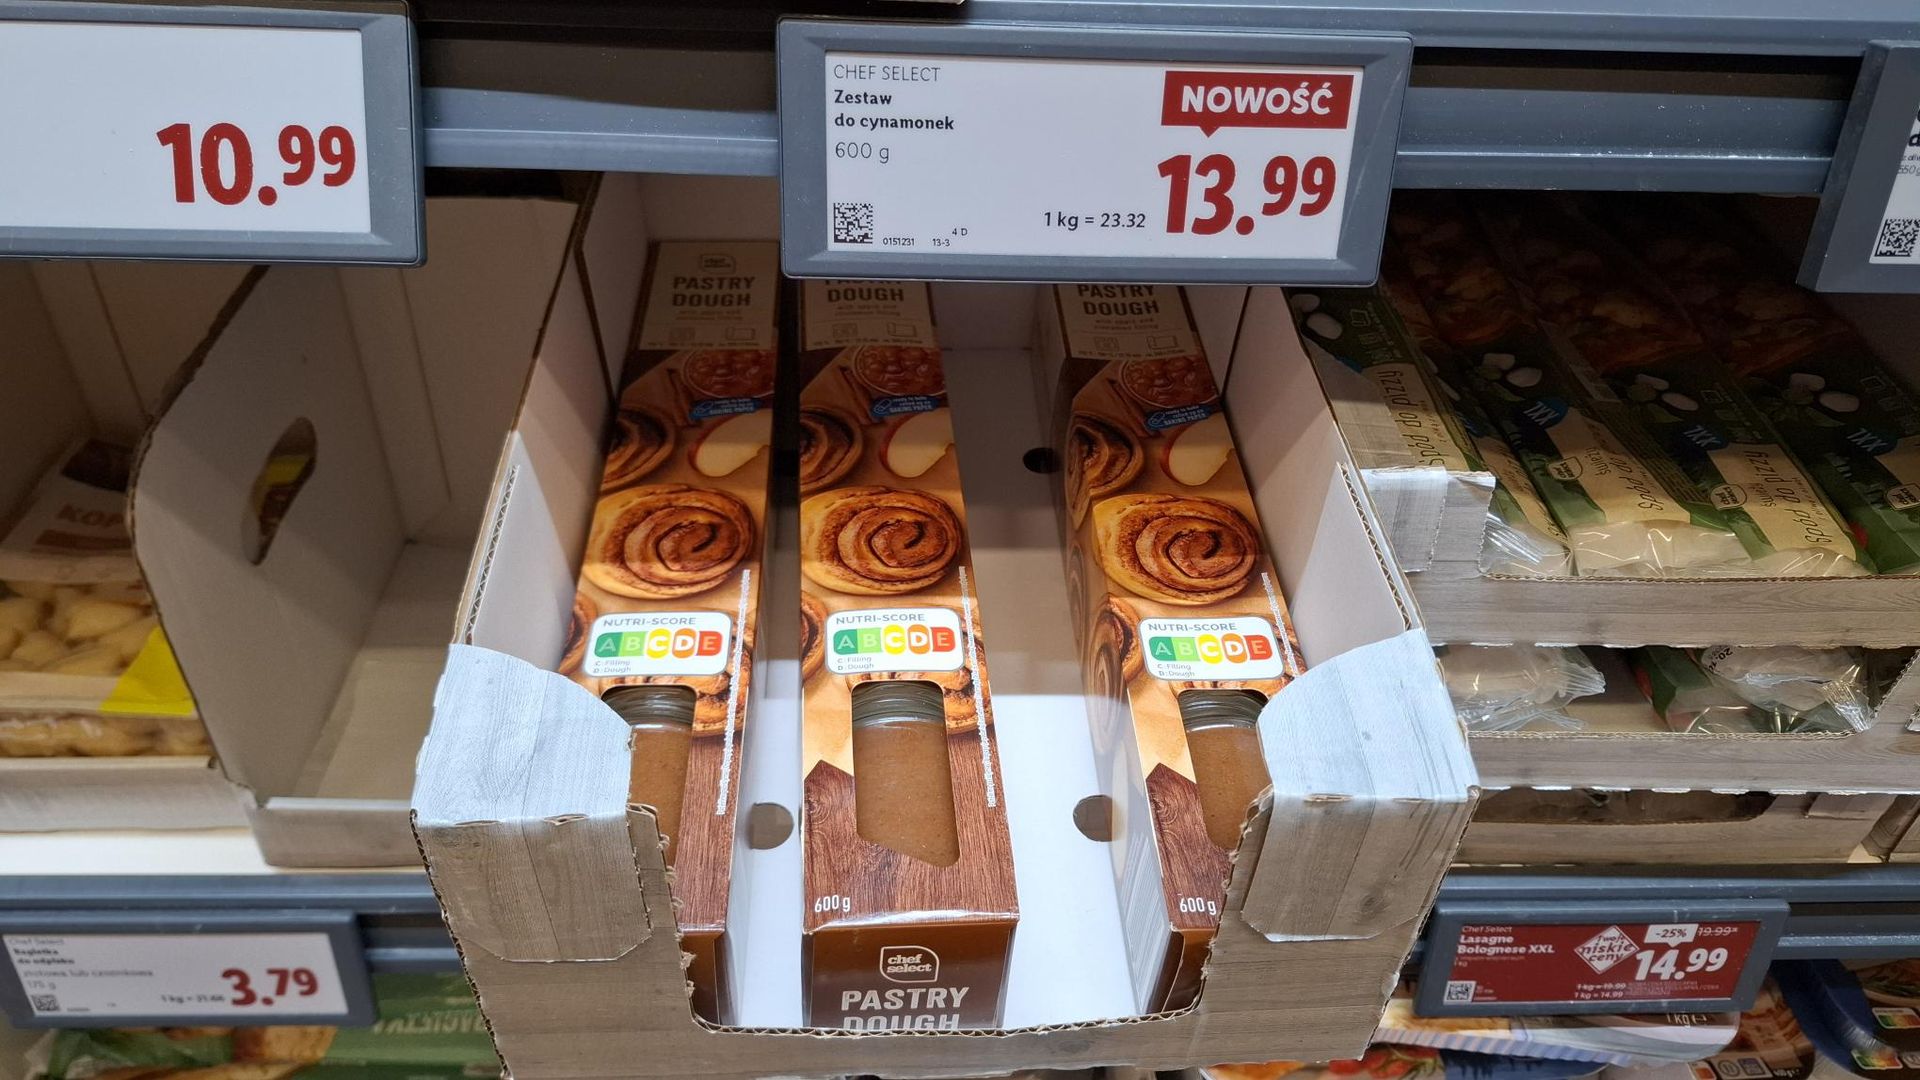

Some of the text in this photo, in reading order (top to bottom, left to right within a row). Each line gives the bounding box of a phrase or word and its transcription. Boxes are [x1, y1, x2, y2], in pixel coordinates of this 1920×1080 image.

[834, 64, 941, 82] CHEF SELECT
[834, 89, 893, 105] Zestaw
[1181, 81, 1334, 115] NOWOŚĆ
[834, 113, 955, 131] do cynamonek
[835, 142, 890, 164] 600 g
[155, 122, 356, 206] 10.99
[1157, 153, 1337, 236] 13.99
[1044, 211, 1147, 231] 1 kg = 23.32
[883, 238, 915, 247] 0151231
[932, 238, 950, 247] 13-3
[673, 276, 755, 290] PASTRY
[1077, 284, 1154, 298] PASTRY
[672, 293, 752, 307] DOUGH
[828, 287, 904, 303] DOUGH
[1083, 300, 1160, 316] DOUGH
[1378, 369, 1419, 407] pizzy
[1395, 411, 1421, 428] do
[1523, 400, 1560, 426] XXL
[1743, 450, 1794, 483] pizzy
[1617, 476, 1665, 512] Spód
[1775, 487, 1801, 505] do
[1783, 508, 1834, 544] Spód
[603, 617, 697, 627] NUTRI-SCORE
[836, 613, 925, 625] NUTRI-SCORE
[1147, 623, 1238, 632] NUTRI-SCORE
[814, 895, 851, 913] 600 g
[1180, 897, 1217, 916] 600 g
[1462, 926, 1513, 934] Chef Select
[1655, 928, 1688, 938] -25%
[1459, 935, 1515, 945] Lasagne
[1457, 943, 1556, 957] Bolognese XXL
[1581, 942, 1634, 955] niskie
[887, 953, 922, 965] chef
[1588, 952, 1624, 964] ceny
[1635, 947, 1729, 981] 14.99
[886, 963, 933, 974] select
[221, 967, 319, 1006] 3.79
[841, 987, 971, 1011] PASTRY
[1580, 991, 1591, 1000] kg
[1600, 991, 1624, 999] 14.99
[843, 1013, 961, 1031] DOUGH
